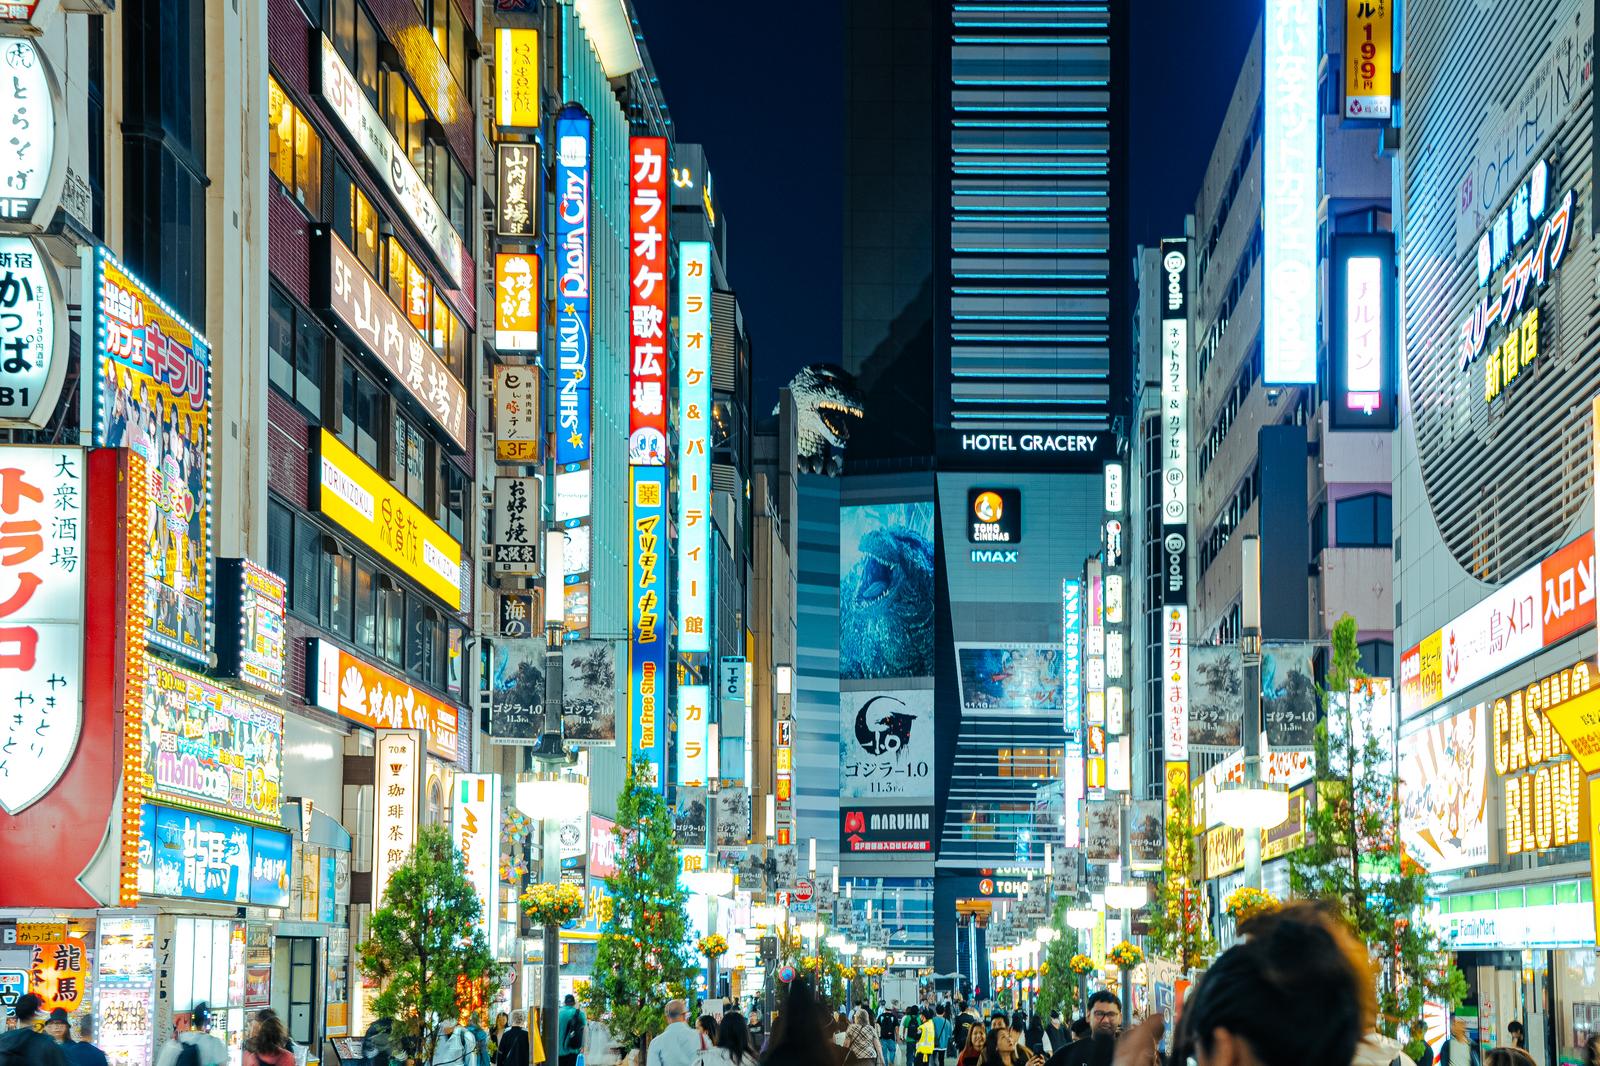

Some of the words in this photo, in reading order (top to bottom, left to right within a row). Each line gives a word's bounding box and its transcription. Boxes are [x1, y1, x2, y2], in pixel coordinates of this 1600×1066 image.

[331, 60, 353, 117] 3F
[334, 257, 352, 303] 5F
[633, 147, 664, 416] カラオケ歌広場
[1164, 250, 1186, 311] Booth
[1458, 189, 1573, 373] スリーファイブ
[145, 320, 205, 412] キラリ
[560, 317, 583, 430] SHINJUKU
[1484, 306, 1539, 405] 新宿店
[506, 442, 528, 456] 3F
[962, 434, 1017, 451] HOTEL
[1020, 435, 1098, 451] GRACERY
[323, 461, 369, 514] TORIKIZOKU
[50, 454, 79, 574] 大衆酒場
[974, 523, 1000, 532] TOHO
[974, 532, 1010, 542] CINEMAS
[636, 515, 661, 644] マツモトキヨシ
[971, 550, 1018, 563] IMAX
[1165, 532, 1186, 592] Booth
[1169, 620, 1183, 670] カラオケ
[640, 661, 657, 695] Shop
[31, 672, 67, 758] やきとり
[640, 696, 655, 724] Free
[640, 725, 655, 749] Tax
[870, 813, 930, 831] MARUHAN
[996, 881, 1029, 894] TOHO
[1460, 917, 1496, 940] FamilyMart
[53, 944, 81, 1003] 龍馬
